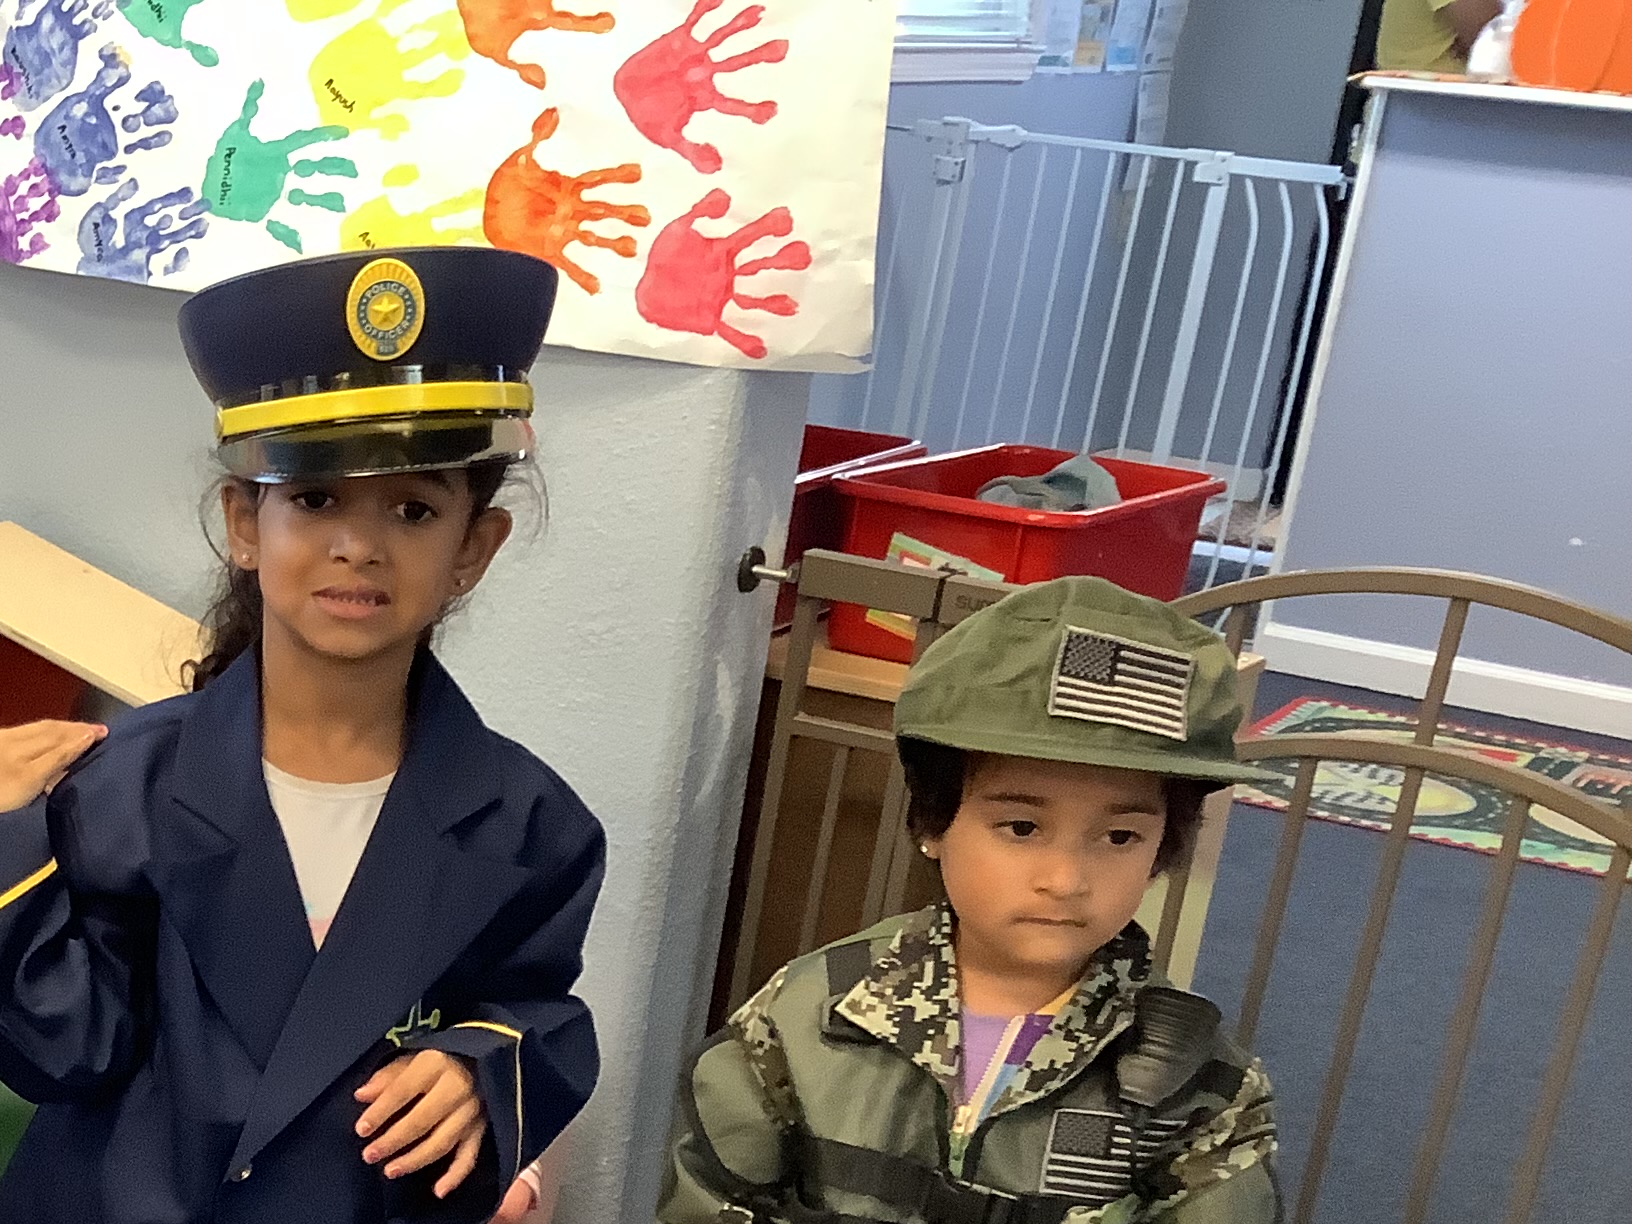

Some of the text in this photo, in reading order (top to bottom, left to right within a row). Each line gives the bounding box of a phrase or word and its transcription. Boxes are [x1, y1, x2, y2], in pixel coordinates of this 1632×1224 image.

[325, 79, 356, 113] Aayush
[365, 282, 407, 299] POLICE
[364, 320, 410, 339] OFFICER
